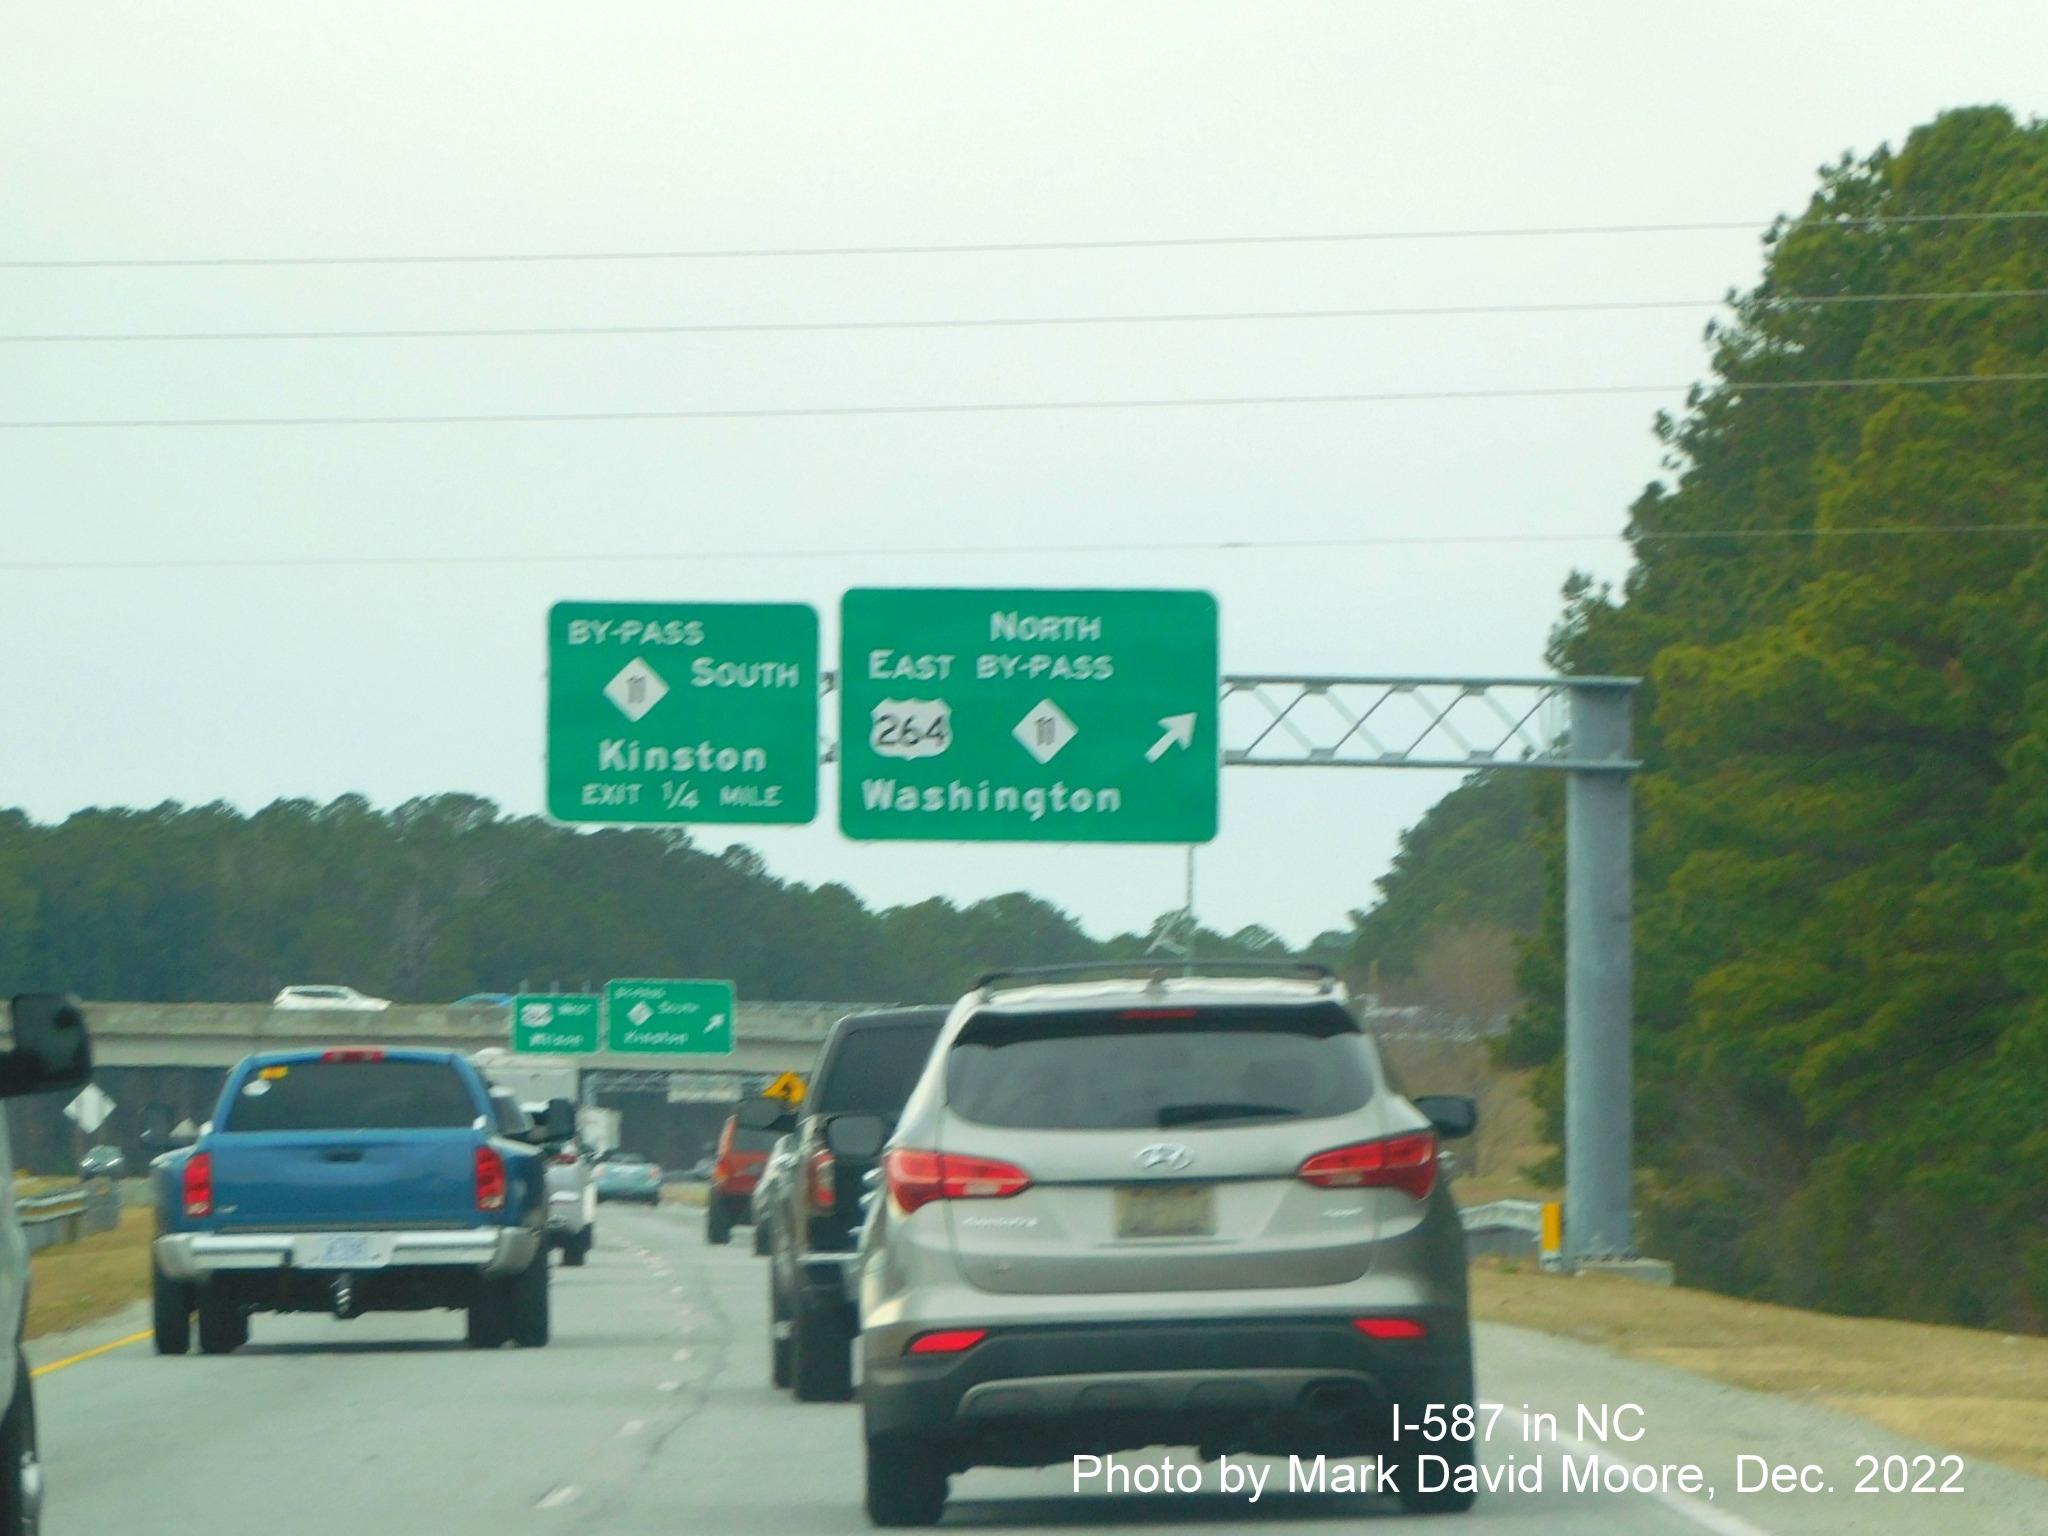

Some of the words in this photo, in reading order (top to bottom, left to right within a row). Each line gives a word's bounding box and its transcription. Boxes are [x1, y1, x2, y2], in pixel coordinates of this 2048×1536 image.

[567, 618, 706, 646] BY-PASS
[990, 610, 1102, 642] NORTH
[690, 656, 800, 689] SOUTH
[867, 649, 956, 681] EAST
[976, 654, 1115, 681] BY-PASS
[872, 714, 950, 748] 264
[1032, 716, 1056, 747] 11
[597, 738, 767, 772] Kinston
[580, 782, 644, 806] EXIT
[719, 785, 783, 807] MILE
[860, 777, 1122, 823] Washington
